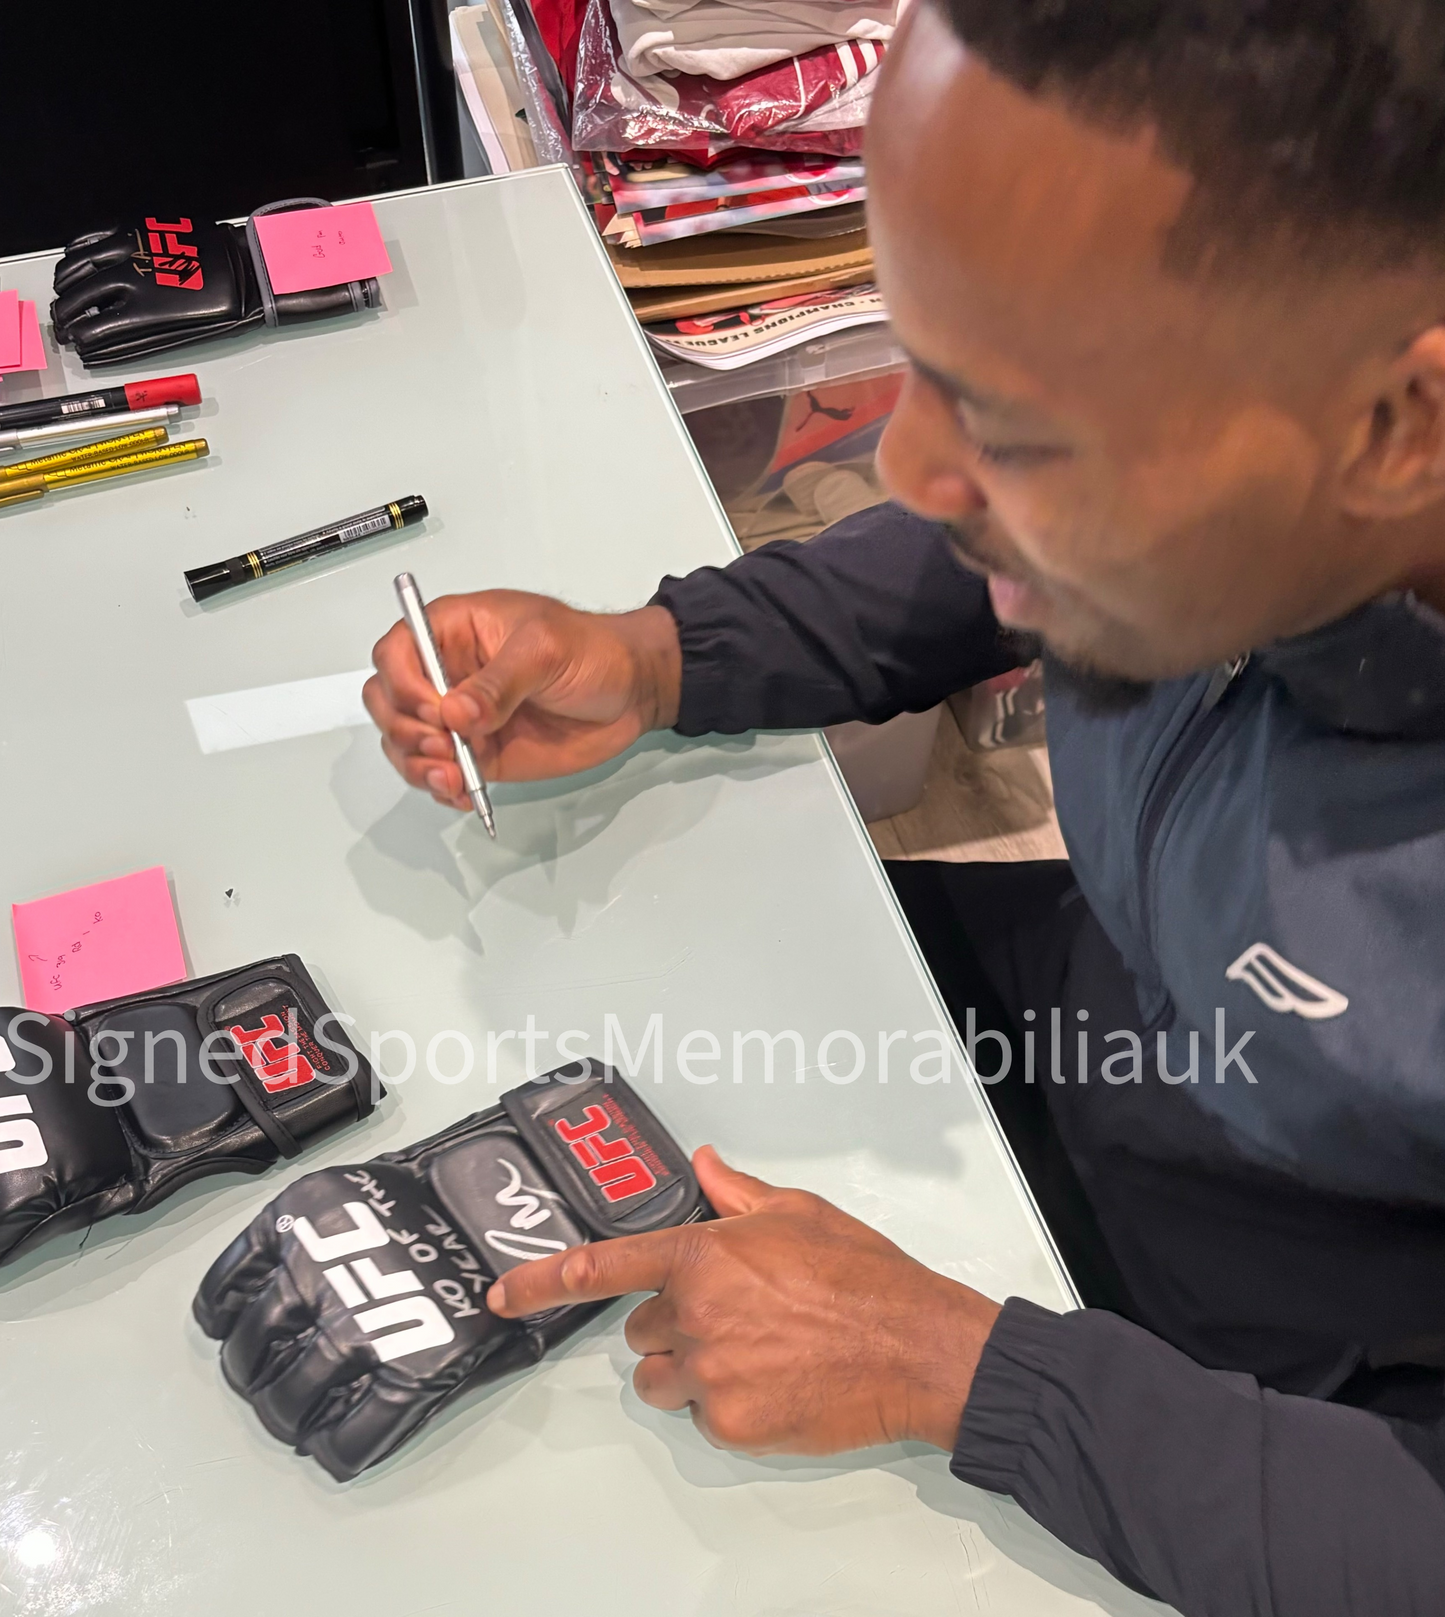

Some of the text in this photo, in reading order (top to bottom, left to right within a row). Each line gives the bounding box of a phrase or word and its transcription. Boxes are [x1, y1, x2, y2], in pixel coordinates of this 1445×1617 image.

[145, 217, 204, 290] UFC
[685, 332, 750, 347] LEAGUE
[754, 301, 856, 335] CHAMPIONS
[230, 1014, 316, 1094] UFC
[554, 1105, 656, 1203] UFC
[292, 1201, 455, 1363] UFC
[343, 1170, 481, 1318] KO OF THE
[421, 1204, 494, 1294] YEAR
